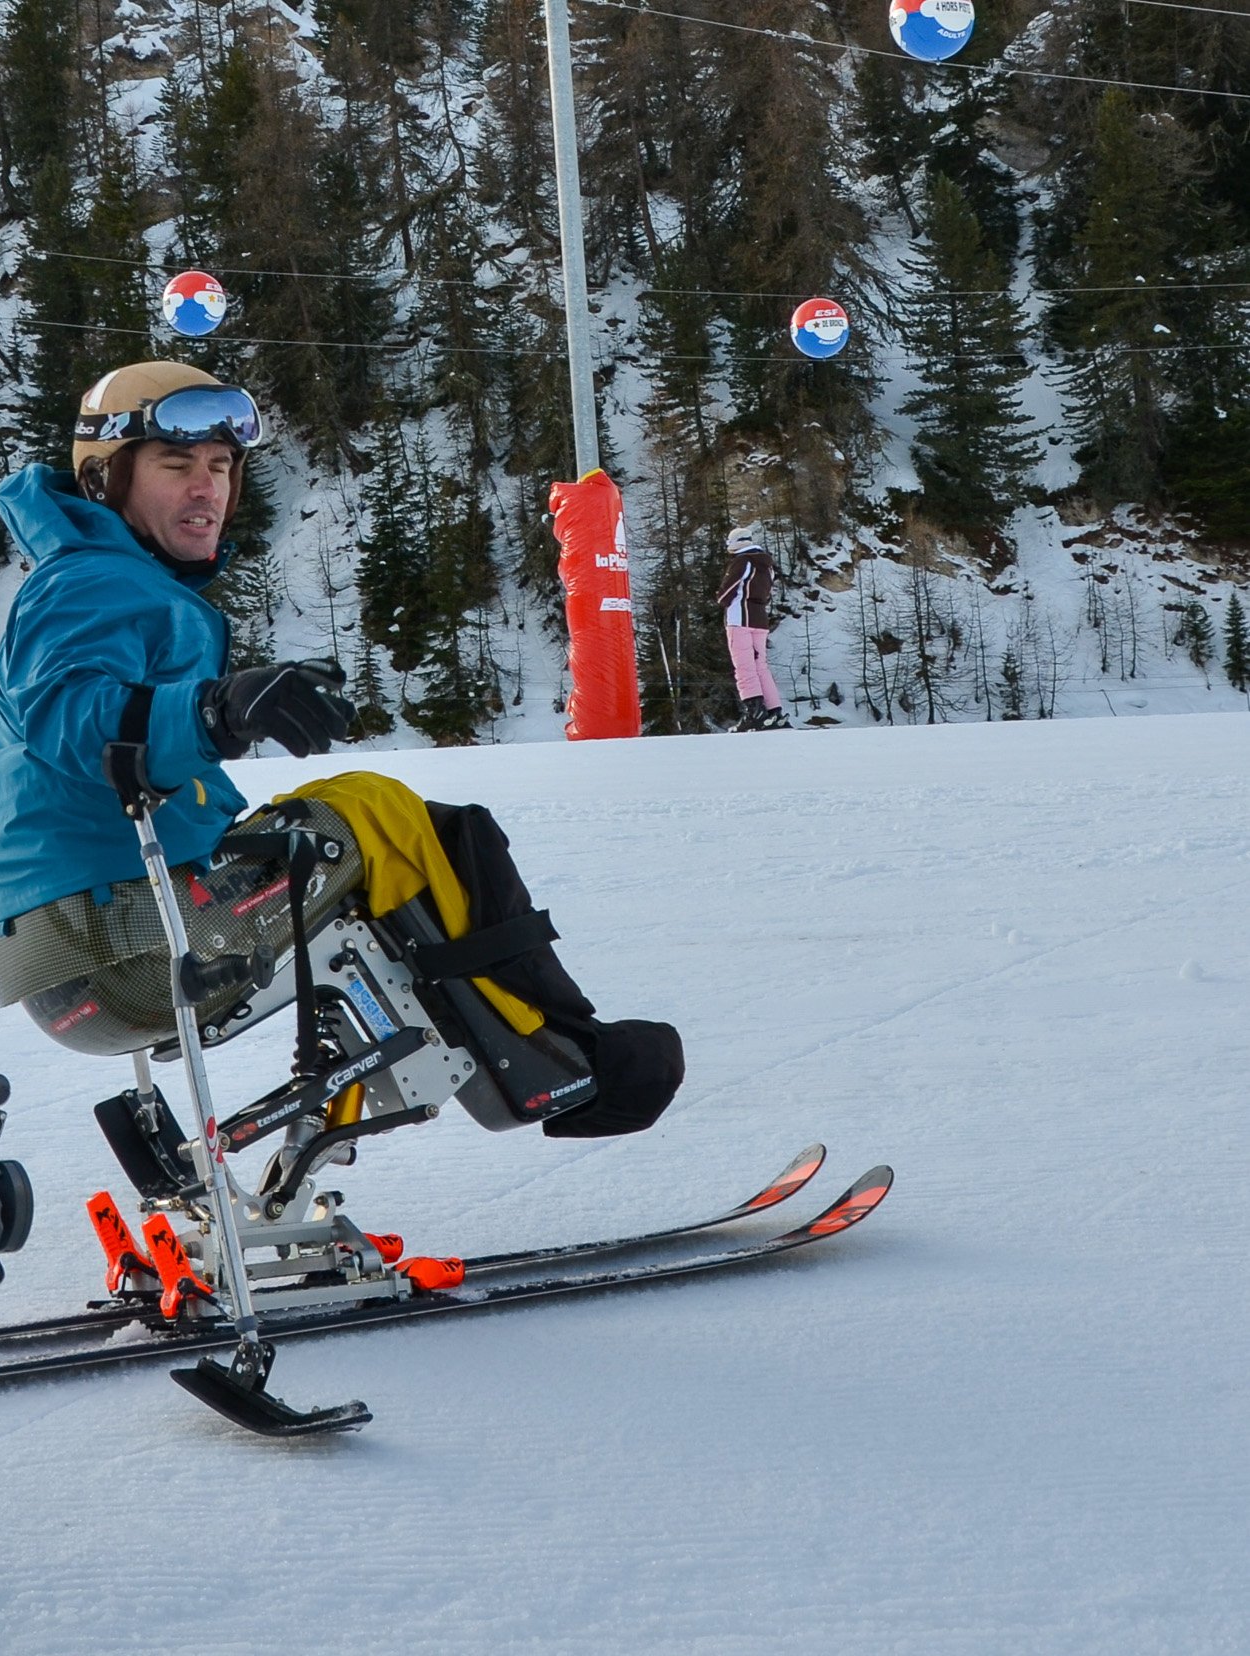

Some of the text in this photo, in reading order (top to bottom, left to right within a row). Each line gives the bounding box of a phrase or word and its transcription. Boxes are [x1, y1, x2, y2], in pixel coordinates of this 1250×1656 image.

[325, 1051, 382, 1100] Scarver
[550, 1076, 592, 1099] tessier
[257, 1099, 301, 1128] tessier
